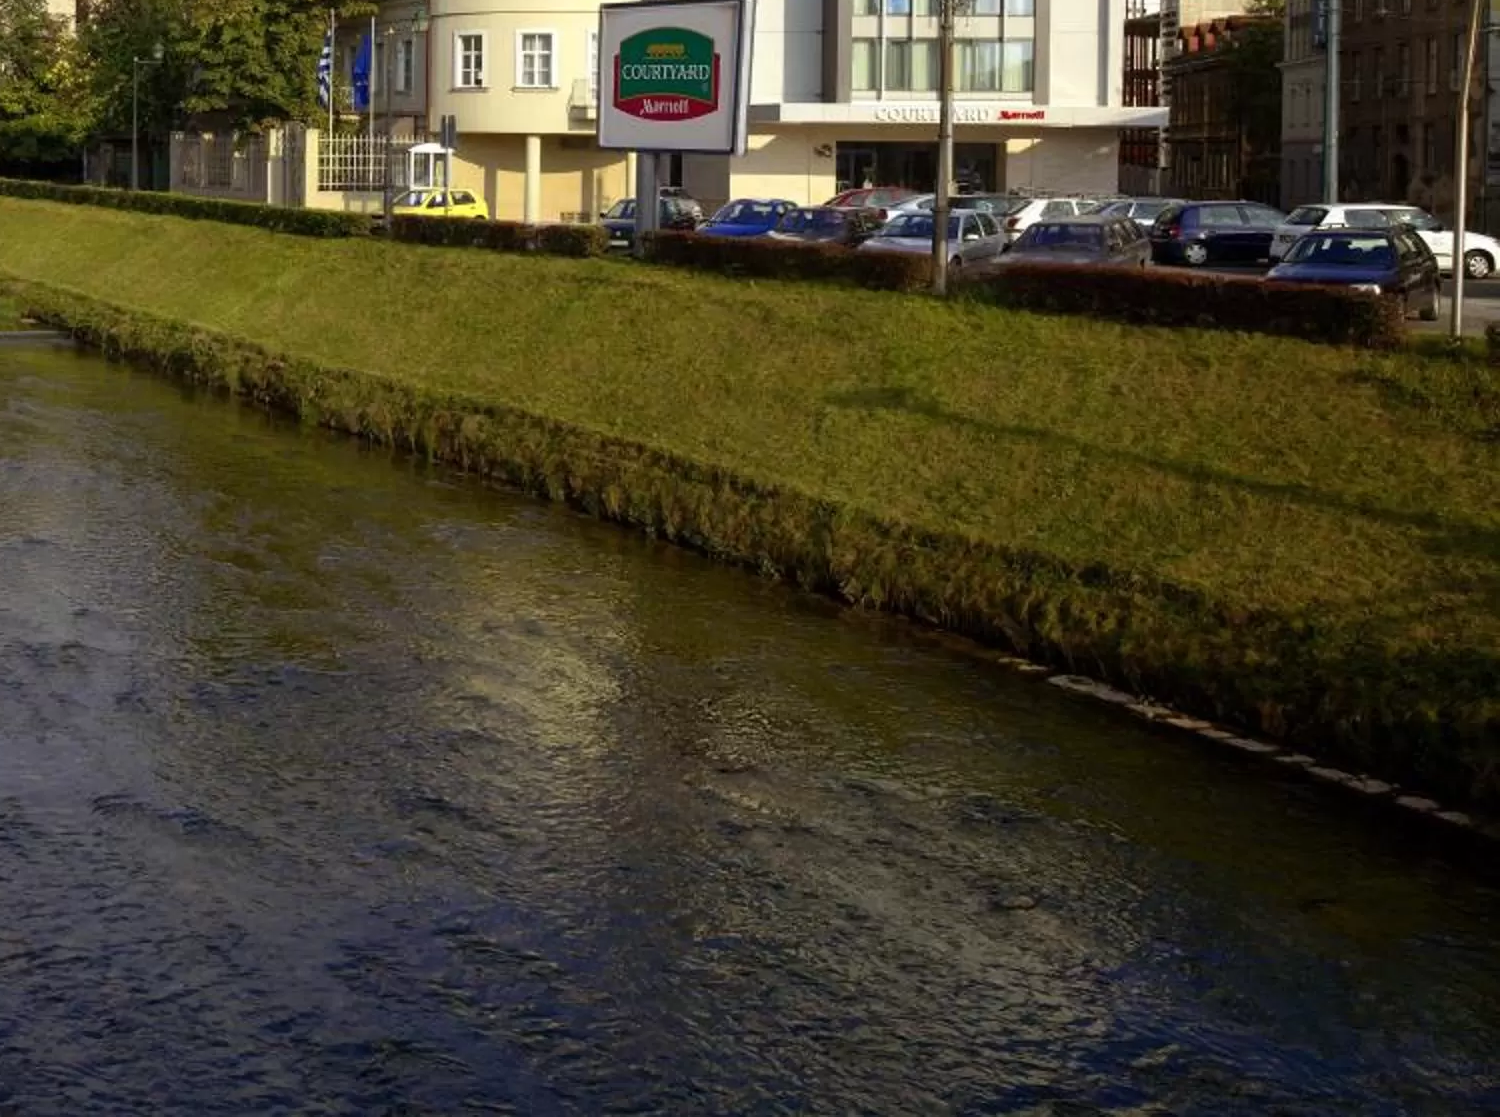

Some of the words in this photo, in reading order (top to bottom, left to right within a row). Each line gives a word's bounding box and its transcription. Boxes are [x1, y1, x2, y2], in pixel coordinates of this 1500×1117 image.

[622, 64, 711, 80] COURTYARD
[639, 98, 689, 116] Marriott
[873, 106, 990, 122] COURTARD
[997, 110, 1045, 121] Marriott
